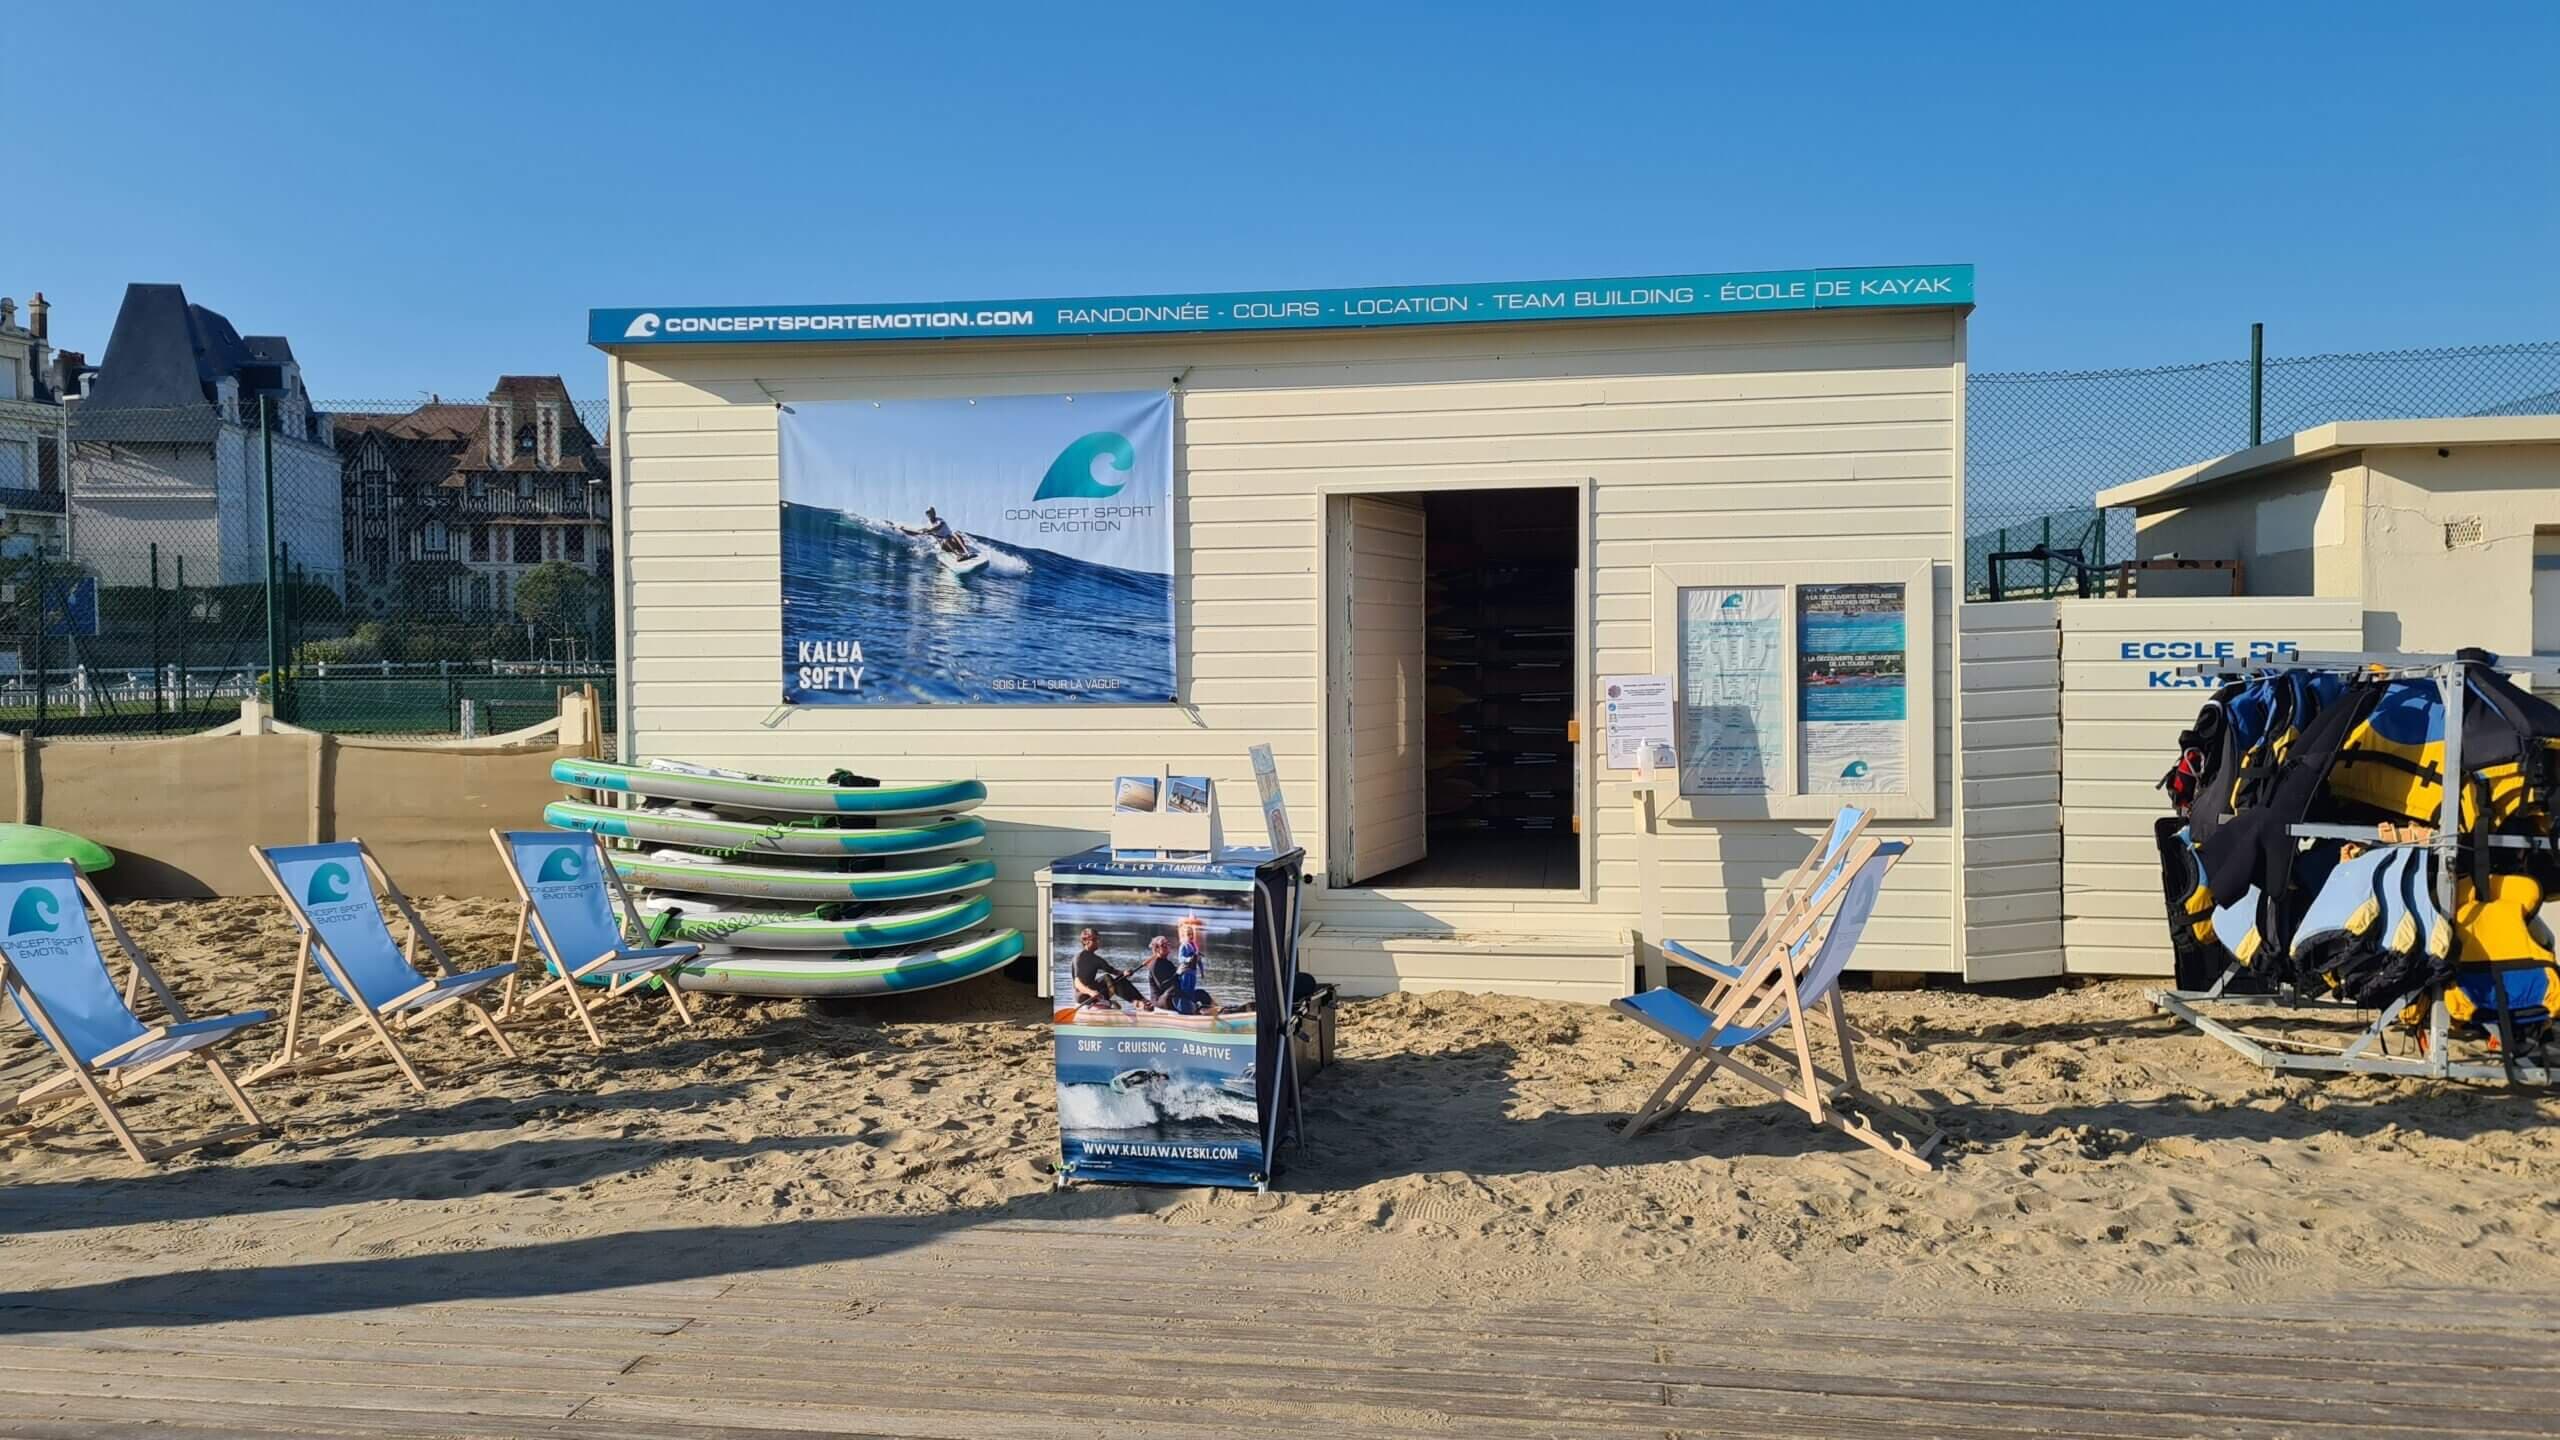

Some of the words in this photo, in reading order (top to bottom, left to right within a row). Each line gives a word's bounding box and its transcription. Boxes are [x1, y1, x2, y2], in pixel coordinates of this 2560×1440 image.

[665, 311, 1033, 332] CONCEPTSPORTEMOTION.COM
[1058, 302, 1209, 324] RANDONNÉE
[1233, 302, 1320, 318] COURS
[1345, 296, 1468, 315] LOCATION
[1493, 293, 1565, 309] TEAM
[1575, 288, 1694, 307] BUILDING
[1720, 282, 1805, 301] ÉCOLE
[1815, 281, 1851, 297] DE
[1861, 277, 1952, 295] KAYAK
[1005, 508, 1089, 520] CONCEPT
[1094, 506, 1155, 518] SPORT
[1039, 521, 1121, 533] EMOTION
[799, 640, 863, 663] KALUA
[2121, 642, 2234, 659] ECOLE
[799, 666, 864, 689] SOFTY
[992, 680, 1015, 689] SOIS
[1048, 680, 1067, 689] SUR
[1070, 680, 1083, 689] LA
[1078, 1040, 1103, 1052] SURF
[1118, 1041, 1167, 1054] CRUISING
[1082, 1141, 1238, 1161] WWW.KALUAWAVESKI.COM
